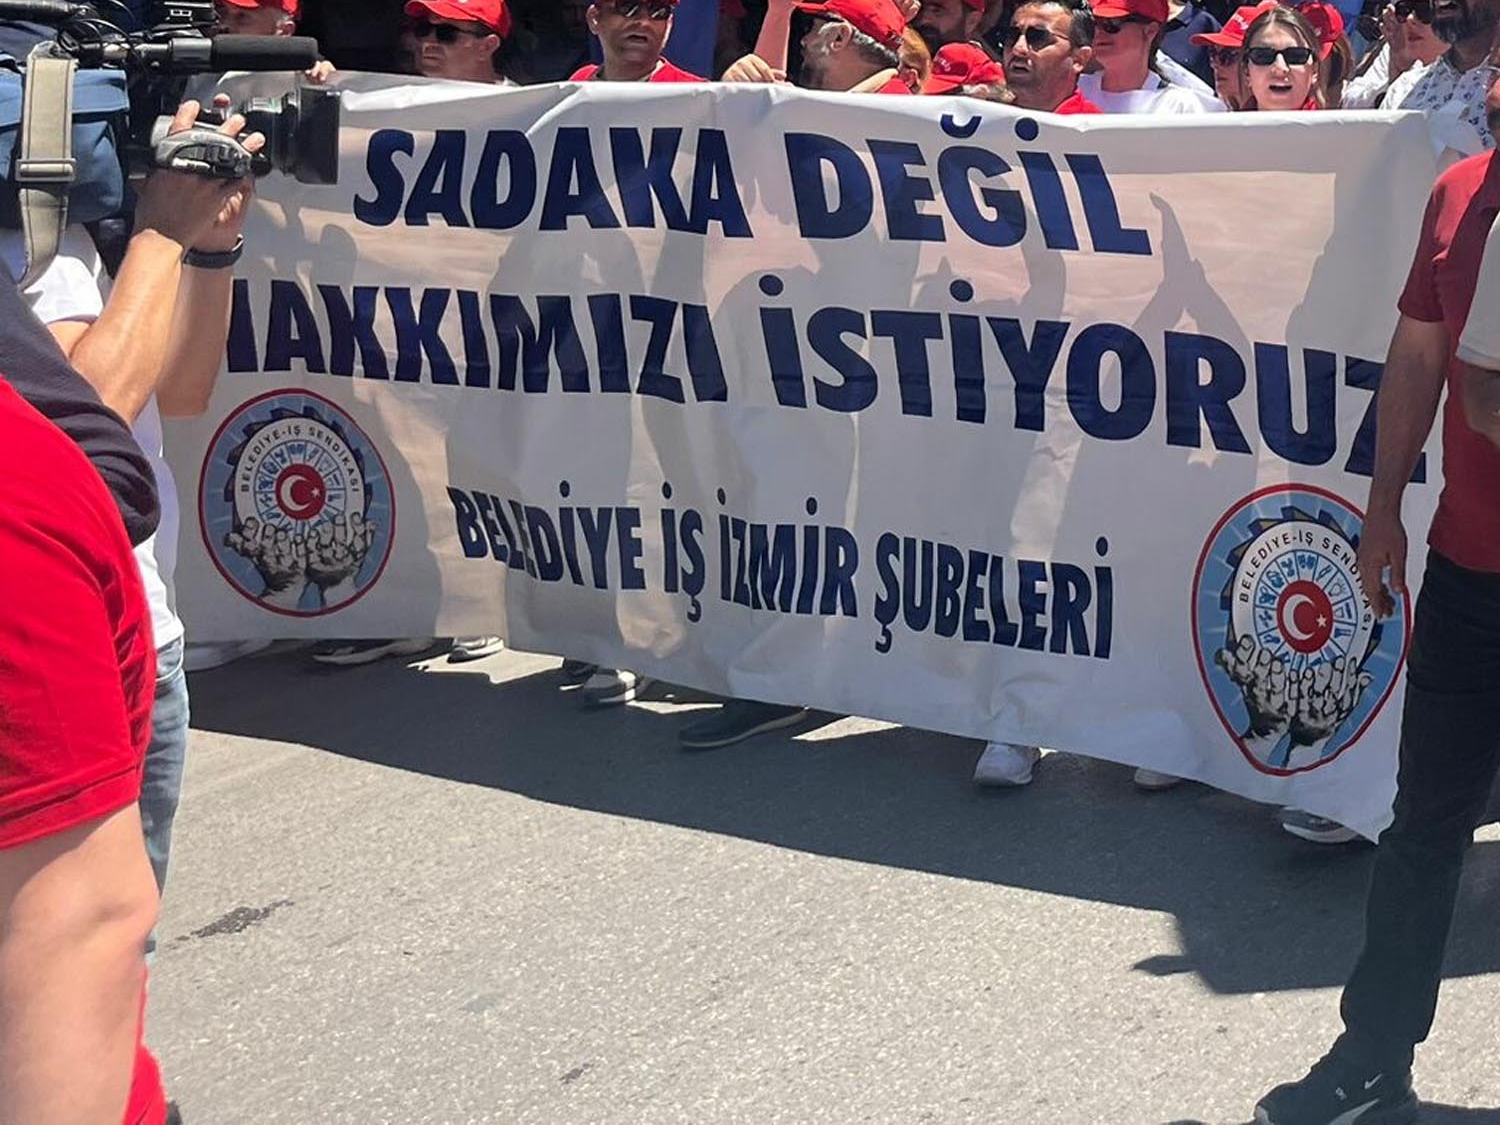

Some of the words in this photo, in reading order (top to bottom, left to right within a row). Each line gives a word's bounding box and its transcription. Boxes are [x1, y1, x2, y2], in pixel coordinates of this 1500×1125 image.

[353, 127, 753, 239] SADAKA
[783, 113, 1153, 256] DEĞİL
[758, 275, 1427, 484] İSTİYORUZ
[308, 427, 360, 492] SENDİKASI
[446, 480, 646, 591] BELEDİYE
[658, 481, 704, 623] İŞ
[716, 488, 860, 617] İZMİR
[873, 535, 1114, 660] ŞUBELERİ
[1240, 530, 1314, 603] BELEDİYE-İŞ
